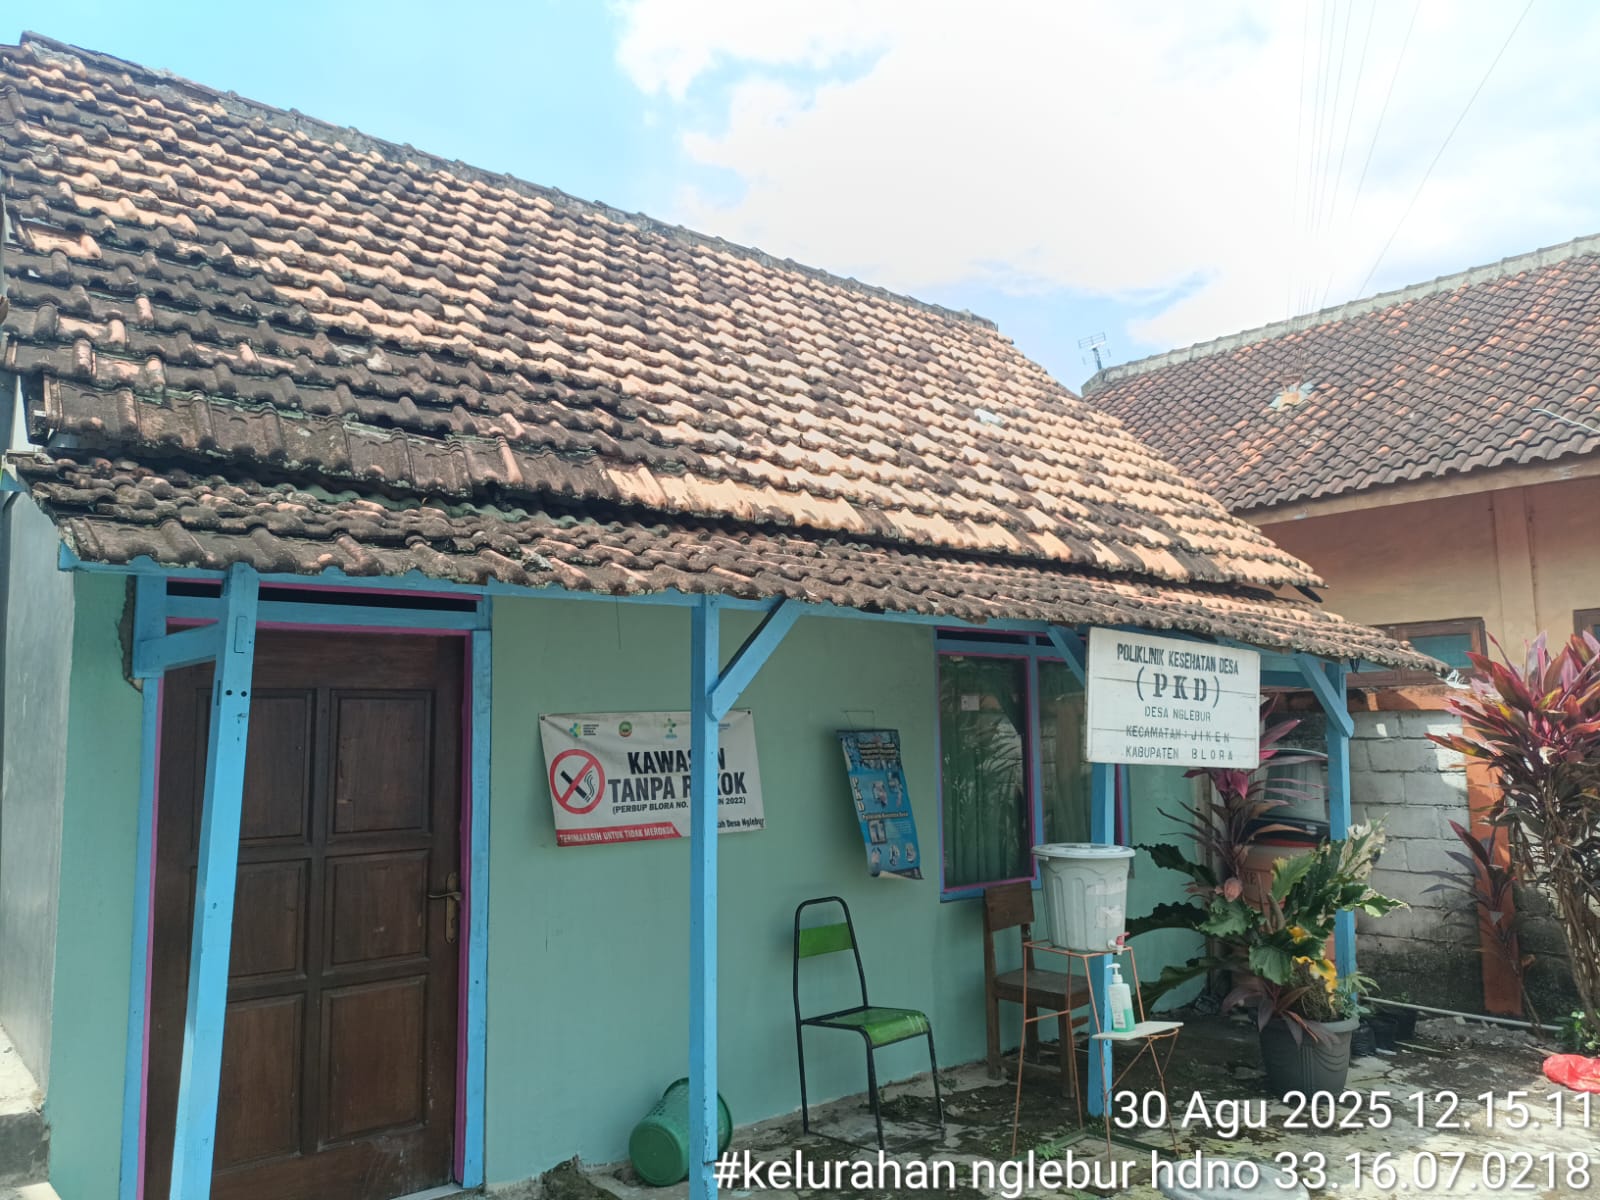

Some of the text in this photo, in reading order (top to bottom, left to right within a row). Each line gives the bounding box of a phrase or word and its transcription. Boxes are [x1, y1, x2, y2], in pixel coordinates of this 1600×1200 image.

[1117, 643, 1239, 675] POLIKLINIK KESEHATAN DESA
[1144, 706, 1211, 722] DESA NGLEBUR
[1191, 731, 1230, 742] JIKEN
[627, 747, 725, 775] KAWAN
[1125, 746, 1233, 760] KABUPATEN BLORA
[608, 772, 747, 803] TANPA ROK
[612, 804, 647, 815] (PERBUP
[649, 802, 674, 811] BLORA
[676, 801, 689, 809] NO.
[725, 796, 746, 805] 2022)
[603, 831, 624, 841] UNTUK
[624, 829, 643, 839] TIDAK
[644, 826, 676, 837] MEROKOK
